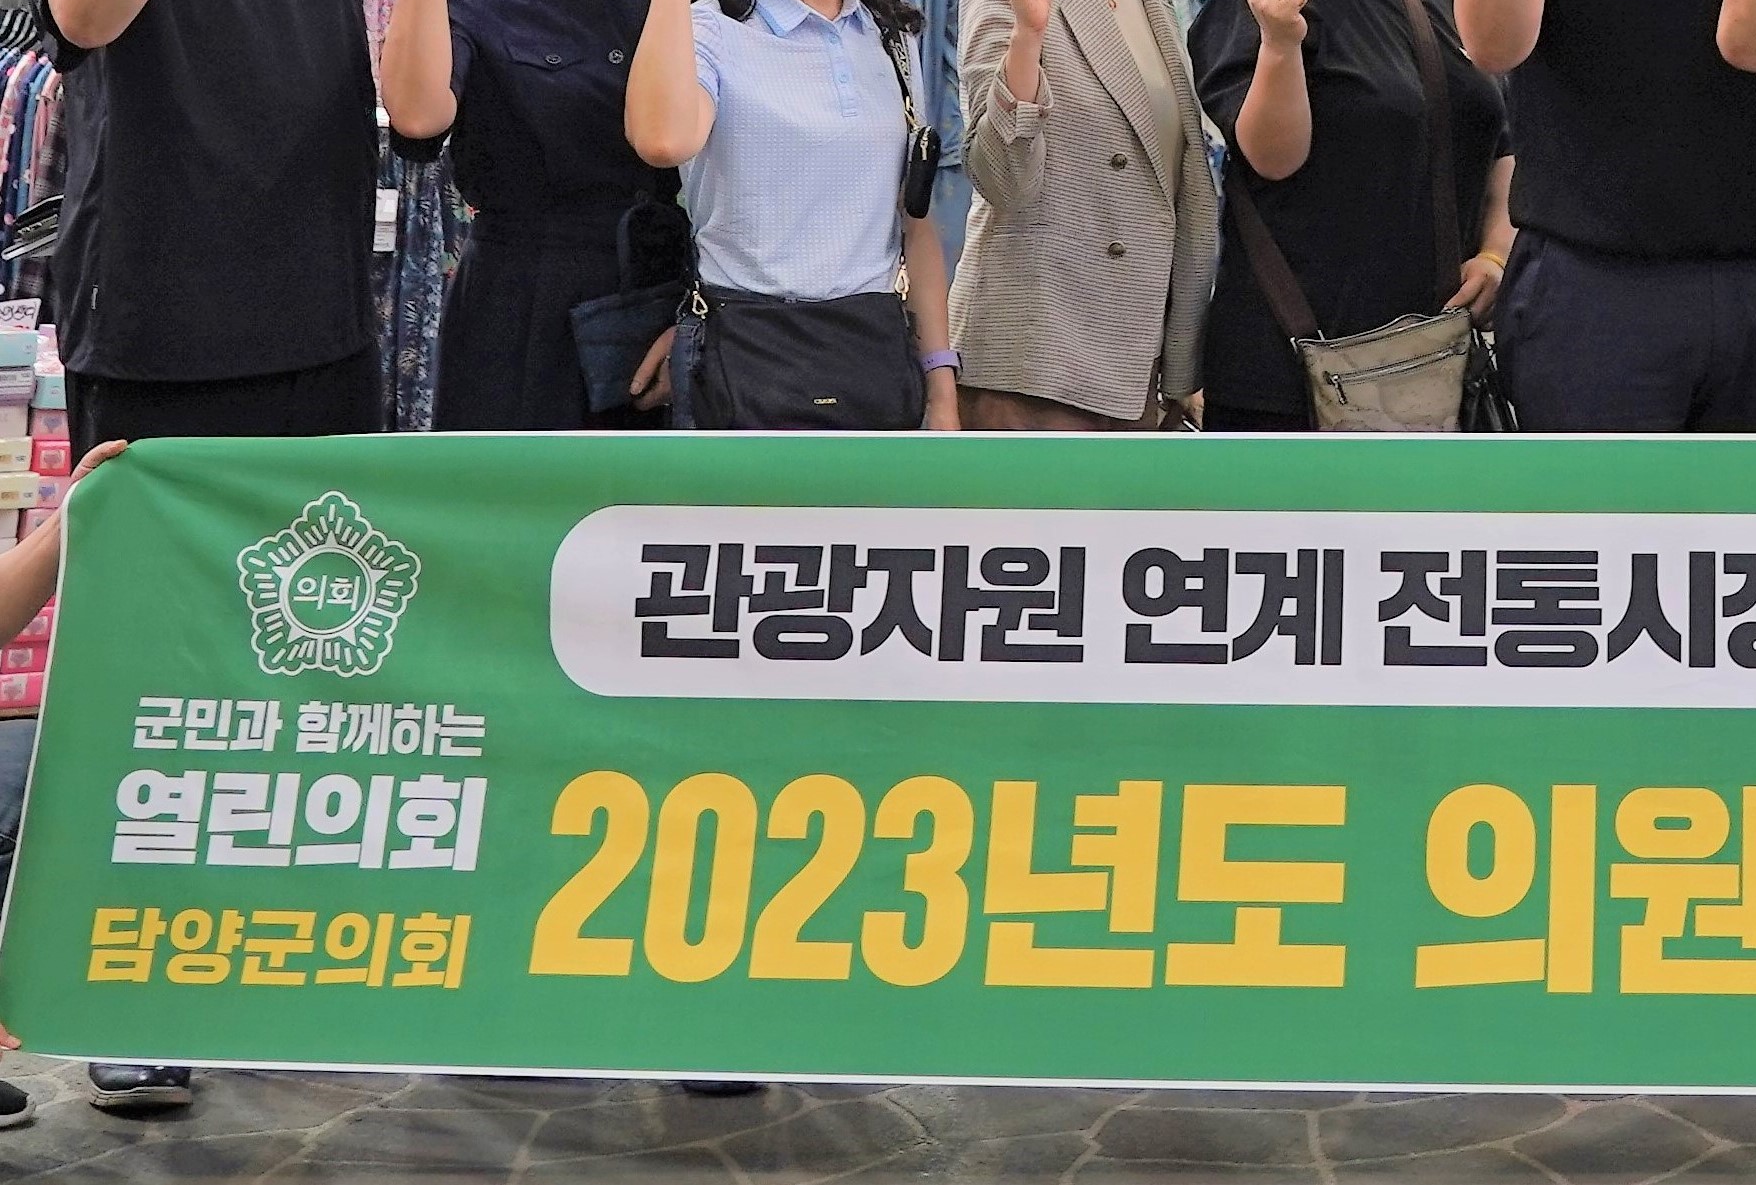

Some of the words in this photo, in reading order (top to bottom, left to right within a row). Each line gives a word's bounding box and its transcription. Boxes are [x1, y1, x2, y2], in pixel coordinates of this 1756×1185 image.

[293, 574, 361, 612] 의회
[635, 543, 1085, 662] 관광자원
[1123, 548, 1344, 665] 연계
[134, 696, 283, 752] 군민과
[295, 700, 486, 757] 함께하는
[111, 769, 488, 871] 열린의회
[529, 771, 1345, 987] 2023년도
[87, 907, 471, 989] 담양군의회
